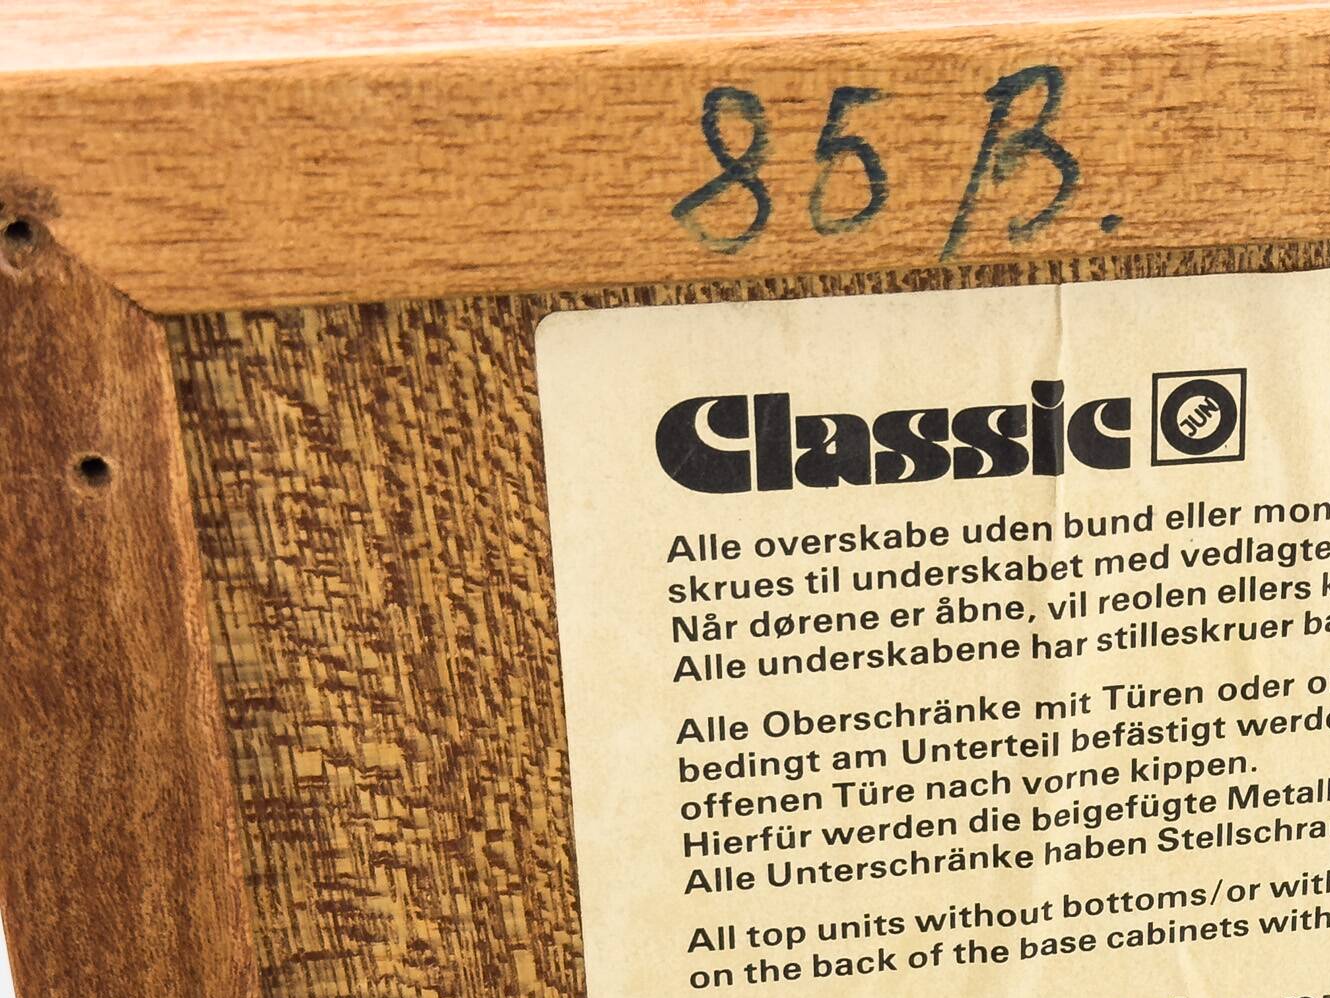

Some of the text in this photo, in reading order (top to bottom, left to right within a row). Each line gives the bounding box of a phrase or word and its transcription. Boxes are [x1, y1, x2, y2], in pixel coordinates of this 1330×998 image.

[671, 85, 891, 255] 85
[655, 379, 1132, 494] Classic
[1179, 397, 1219, 437] JUN
[666, 533, 742, 563] Alle
[754, 520, 950, 558] overskabe
[962, 514, 1052, 544] uden
[1064, 504, 1154, 539] bund
[1165, 501, 1242, 530] eller
[668, 575, 794, 604] skrues
[804, 565, 840, 595] til
[852, 554, 1084, 592] underskabet
[1095, 543, 1170, 577] med
[672, 612, 738, 643] Når
[749, 610, 880, 639] dørene
[890, 607, 926, 628] er
[935, 596, 1036, 625] åbne,
[1047, 590, 1087, 620] vil
[1098, 582, 1206, 615] reolen
[1217, 575, 1312, 604] ellers
[672, 653, 746, 683] Alle
[758, 637, 1021, 677] underskabene
[1032, 633, 1088, 660] har
[1096, 617, 1294, 652] stilleskruer
[676, 715, 749, 745] Alle
[763, 695, 1021, 738] Oberschränke
[1035, 691, 1092, 720] mit
[1102, 684, 1204, 711] Türen
[1217, 674, 1295, 702] oder
[678, 750, 821, 783] bedingt
[832, 749, 887, 771] am
[902, 731, 1059, 765] Unterteil
[1071, 716, 1226, 753] befästigt
[680, 755, 1257, 821] offenen Türe nach vorne kippen.
[683, 825, 812, 858] Hierfür
[821, 814, 957, 846] werden
[968, 806, 1021, 834] die
[1032, 792, 1217, 832] beigefügte
[684, 866, 756, 895] Alle
[767, 843, 1034, 888] Unterschränke
[1044, 834, 1147, 866] haben
[687, 924, 736, 954] All
[746, 926, 806, 951] top
[818, 913, 905, 942] units
[914, 900, 1053, 933] without
[1063, 878, 1261, 919] bottoms/or
[689, 968, 734, 989] on
[743, 958, 802, 984] the
[812, 947, 898, 978] back
[908, 942, 944, 969] of
[952, 939, 1010, 965] the
[1020, 934, 1097, 961] base
[1106, 917, 1250, 949] cabinets
